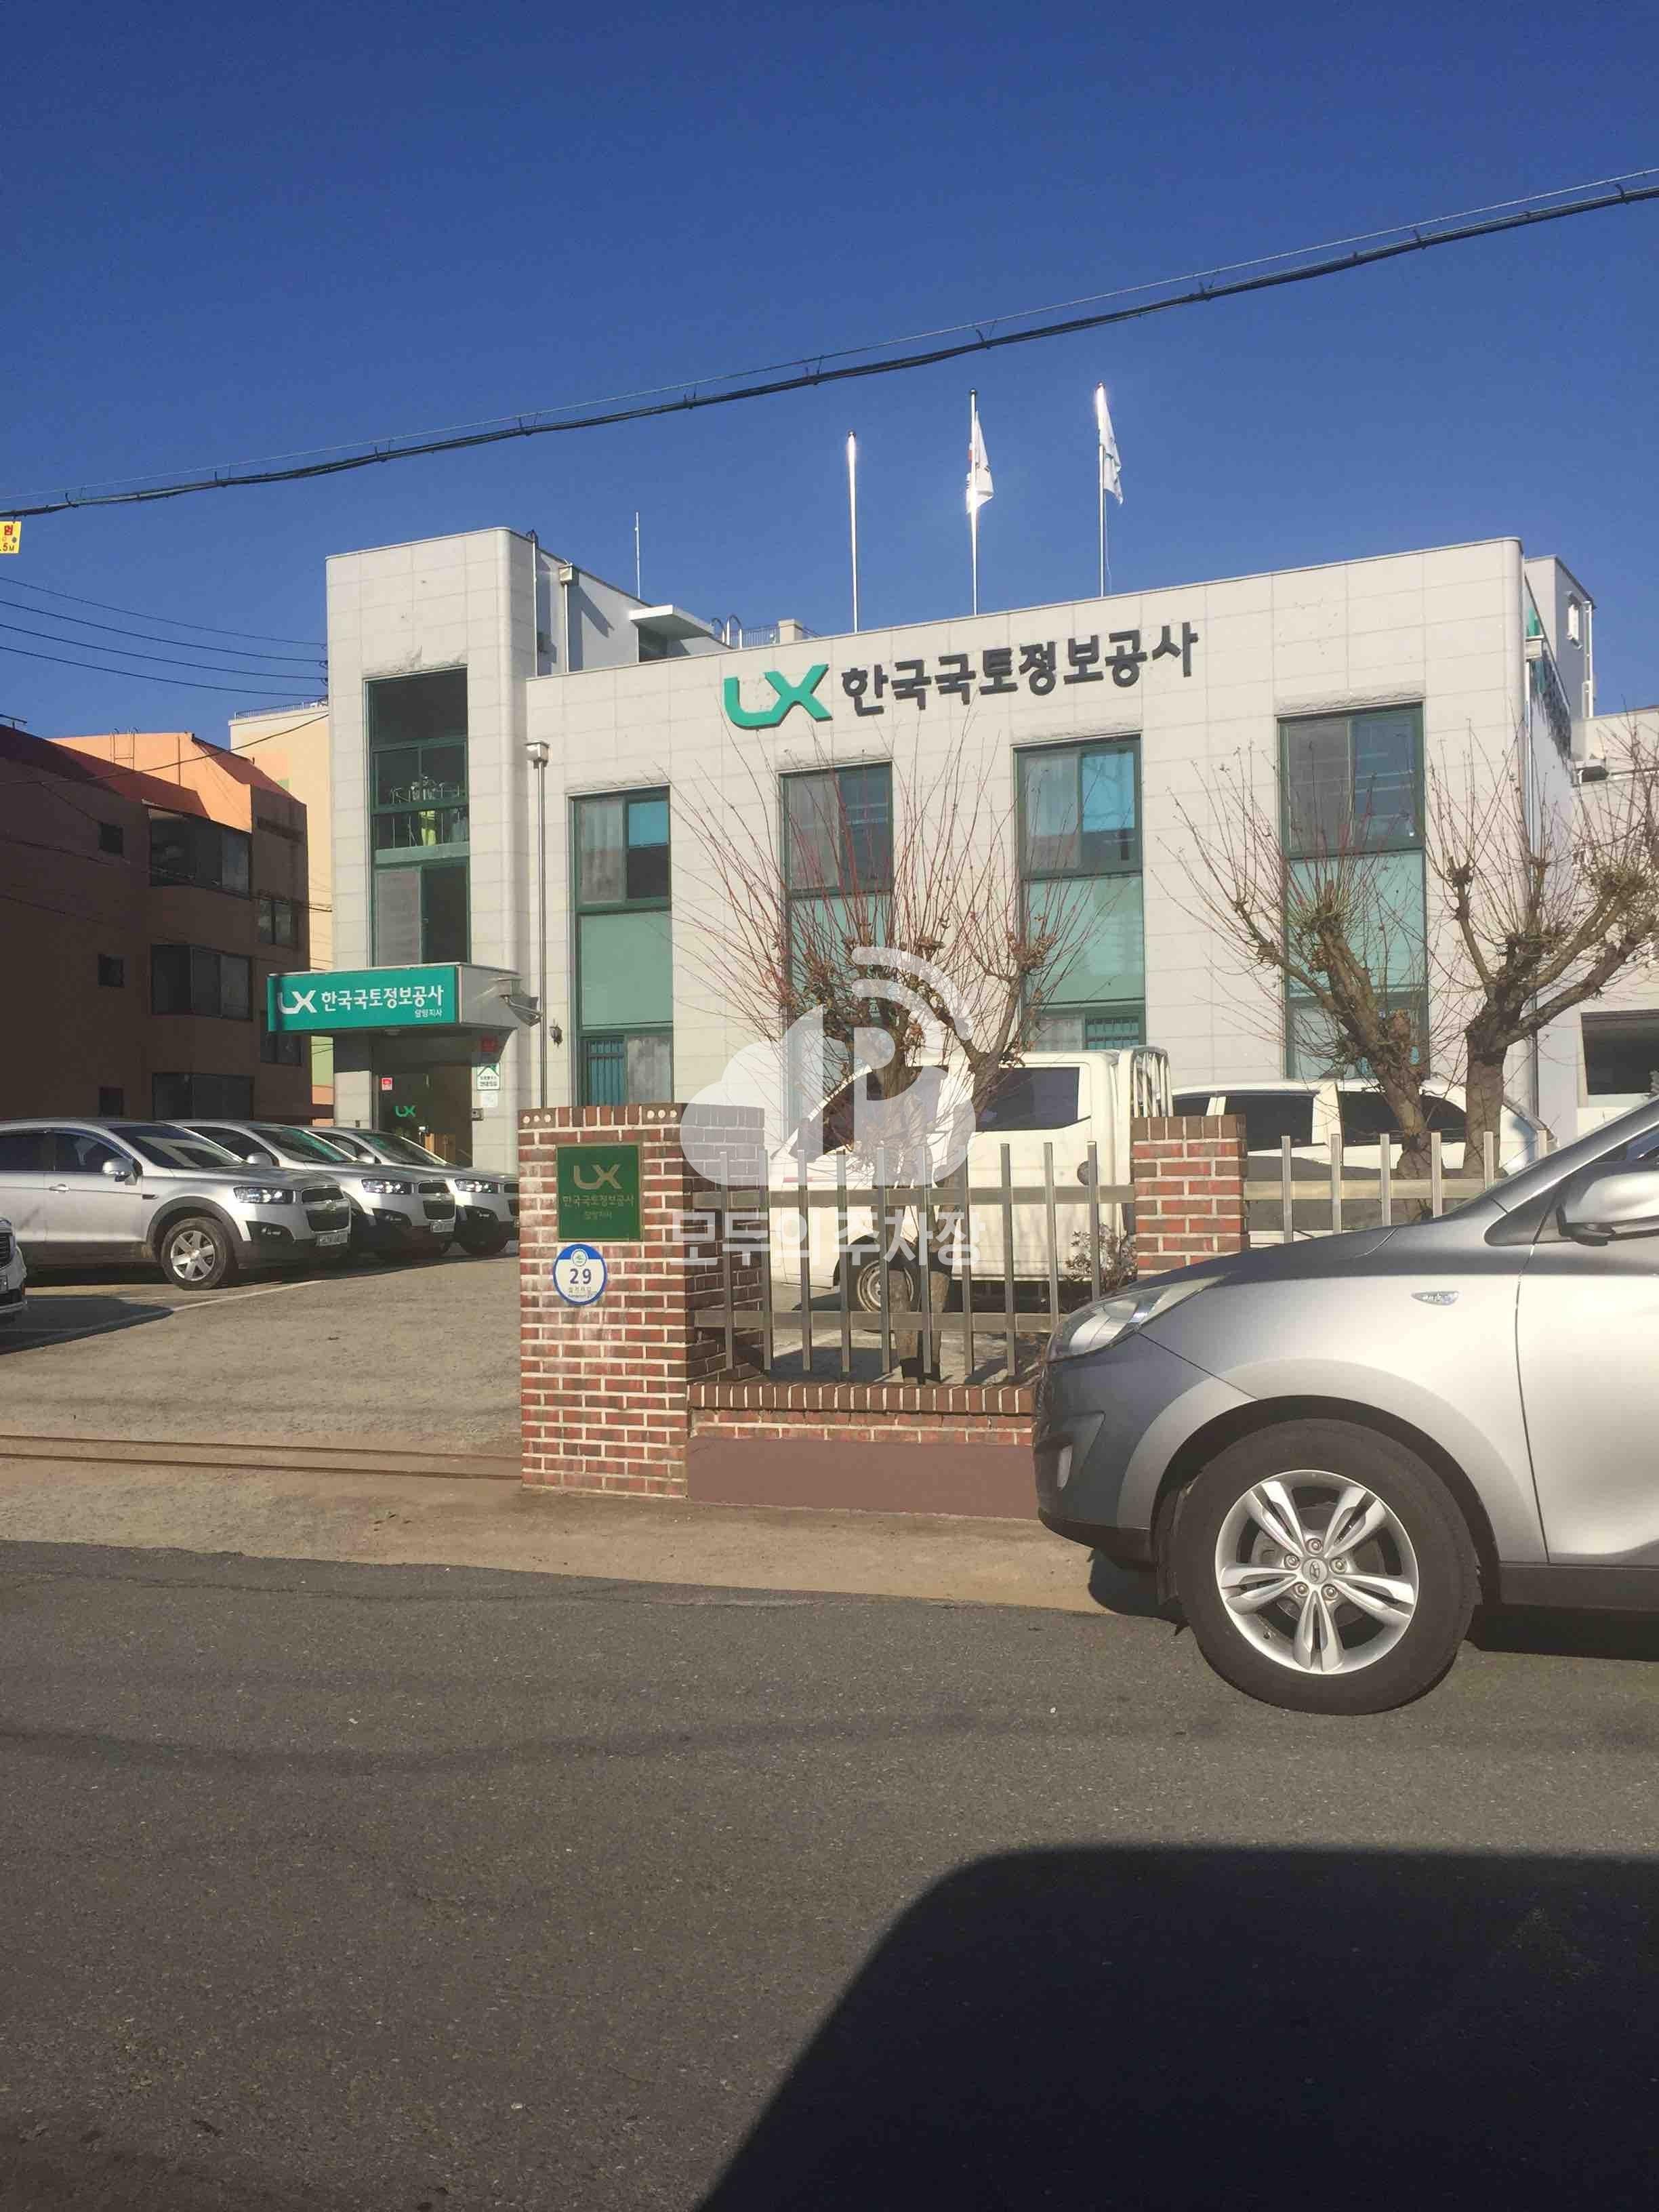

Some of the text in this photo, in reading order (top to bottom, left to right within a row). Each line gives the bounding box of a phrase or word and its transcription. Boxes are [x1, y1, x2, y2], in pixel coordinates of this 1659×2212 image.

[841, 621, 1200, 717] 한국국토정보공사
[321, 985, 444, 1012] 한국국토정보공사
[570, 1268, 592, 1284] 29
